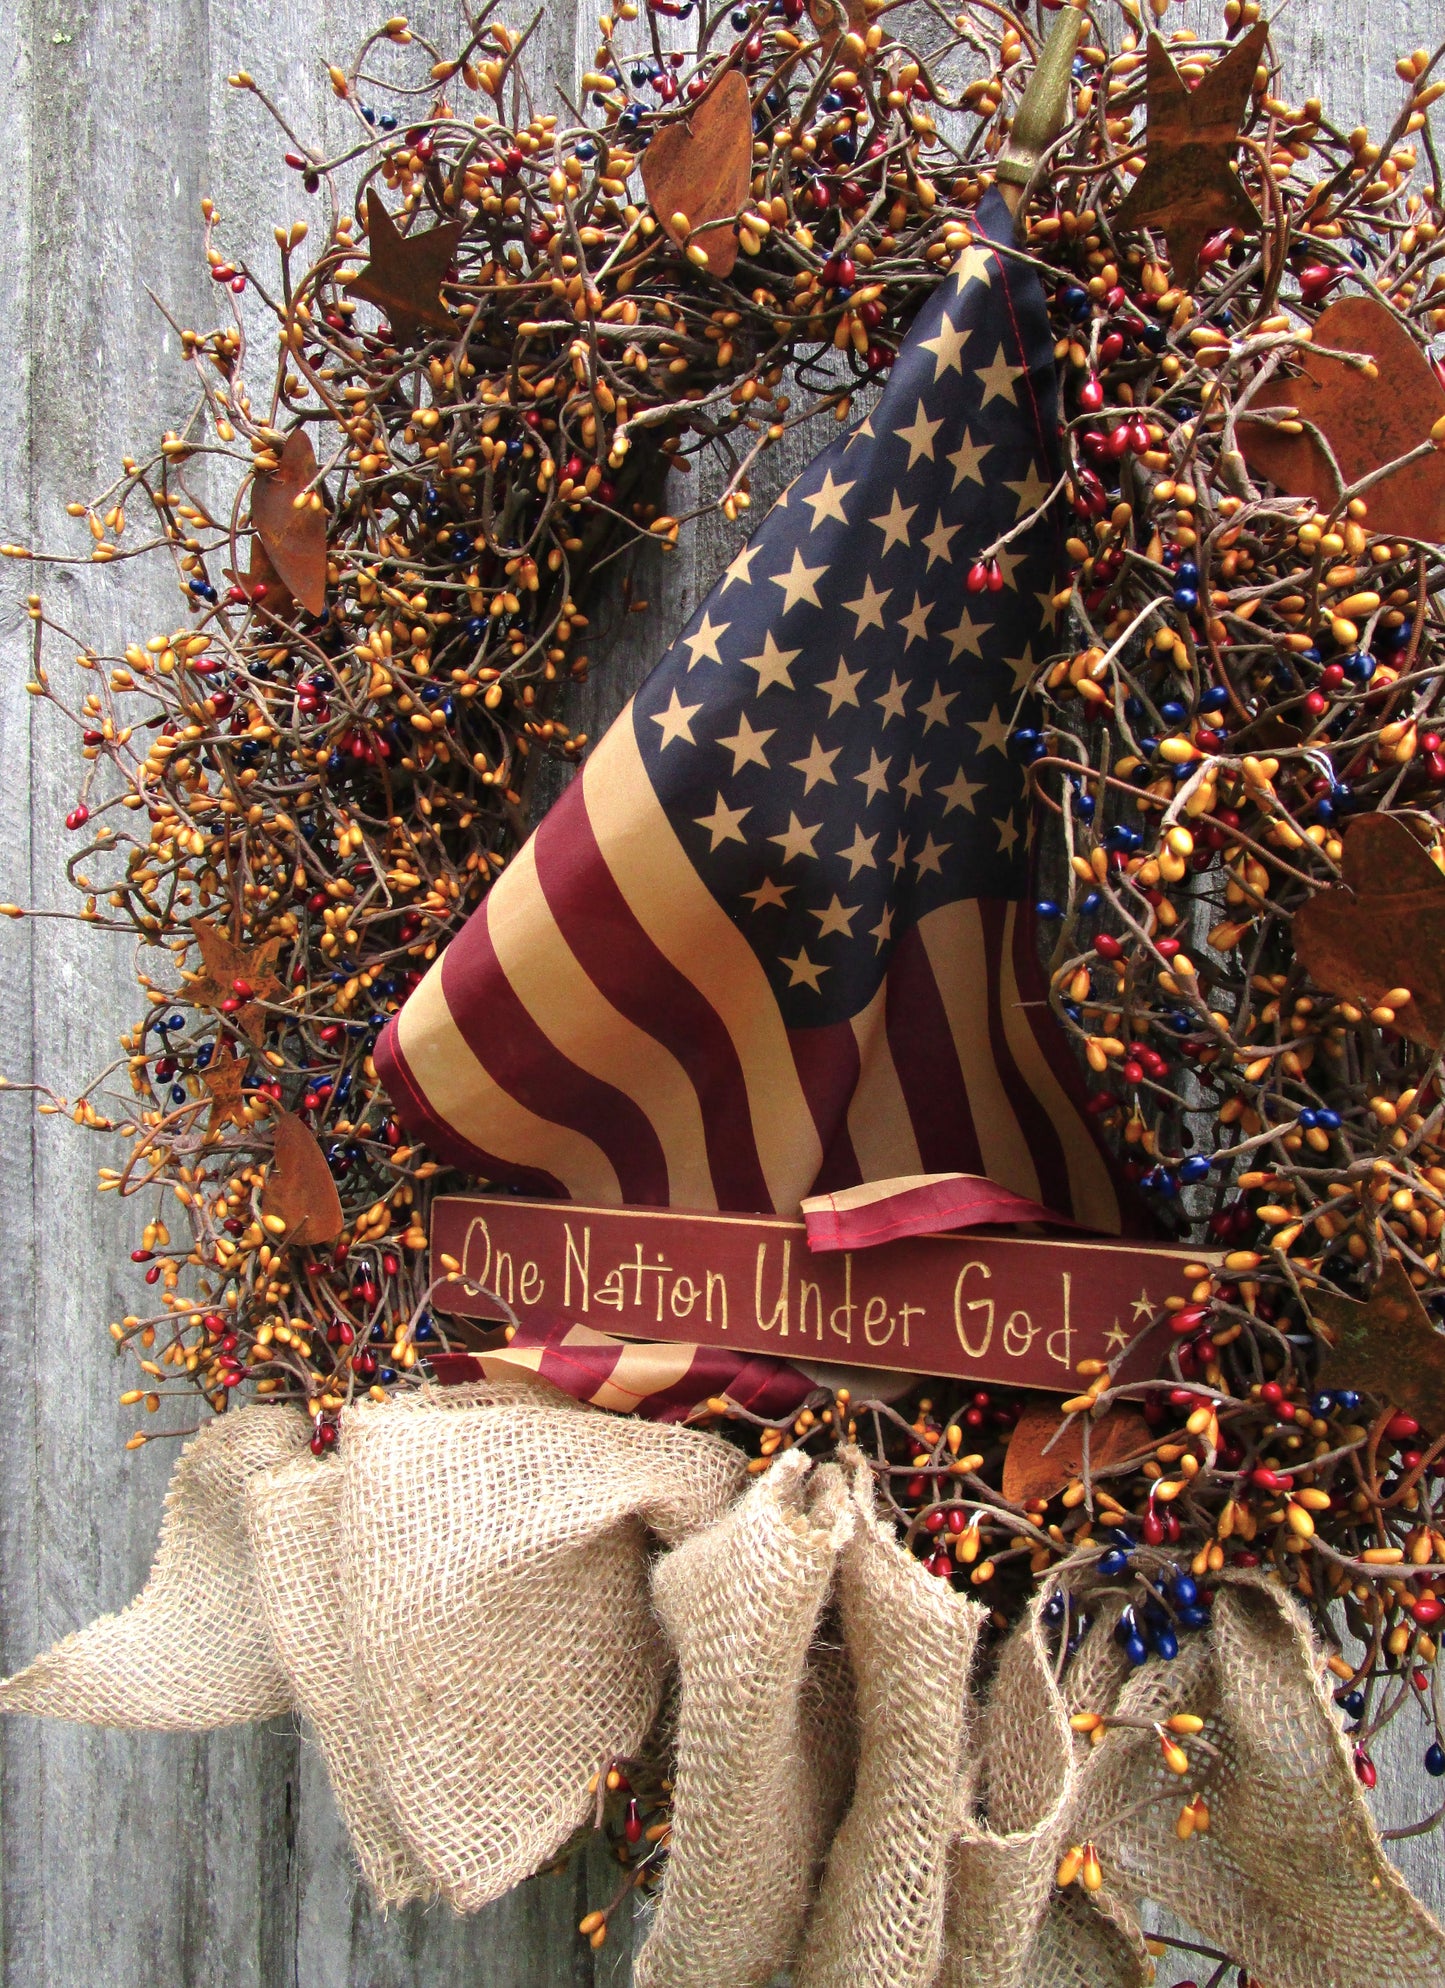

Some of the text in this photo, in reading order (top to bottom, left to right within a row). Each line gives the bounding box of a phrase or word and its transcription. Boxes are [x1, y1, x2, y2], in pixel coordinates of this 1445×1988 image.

[462, 1215, 1078, 1370] One Nation Under God
